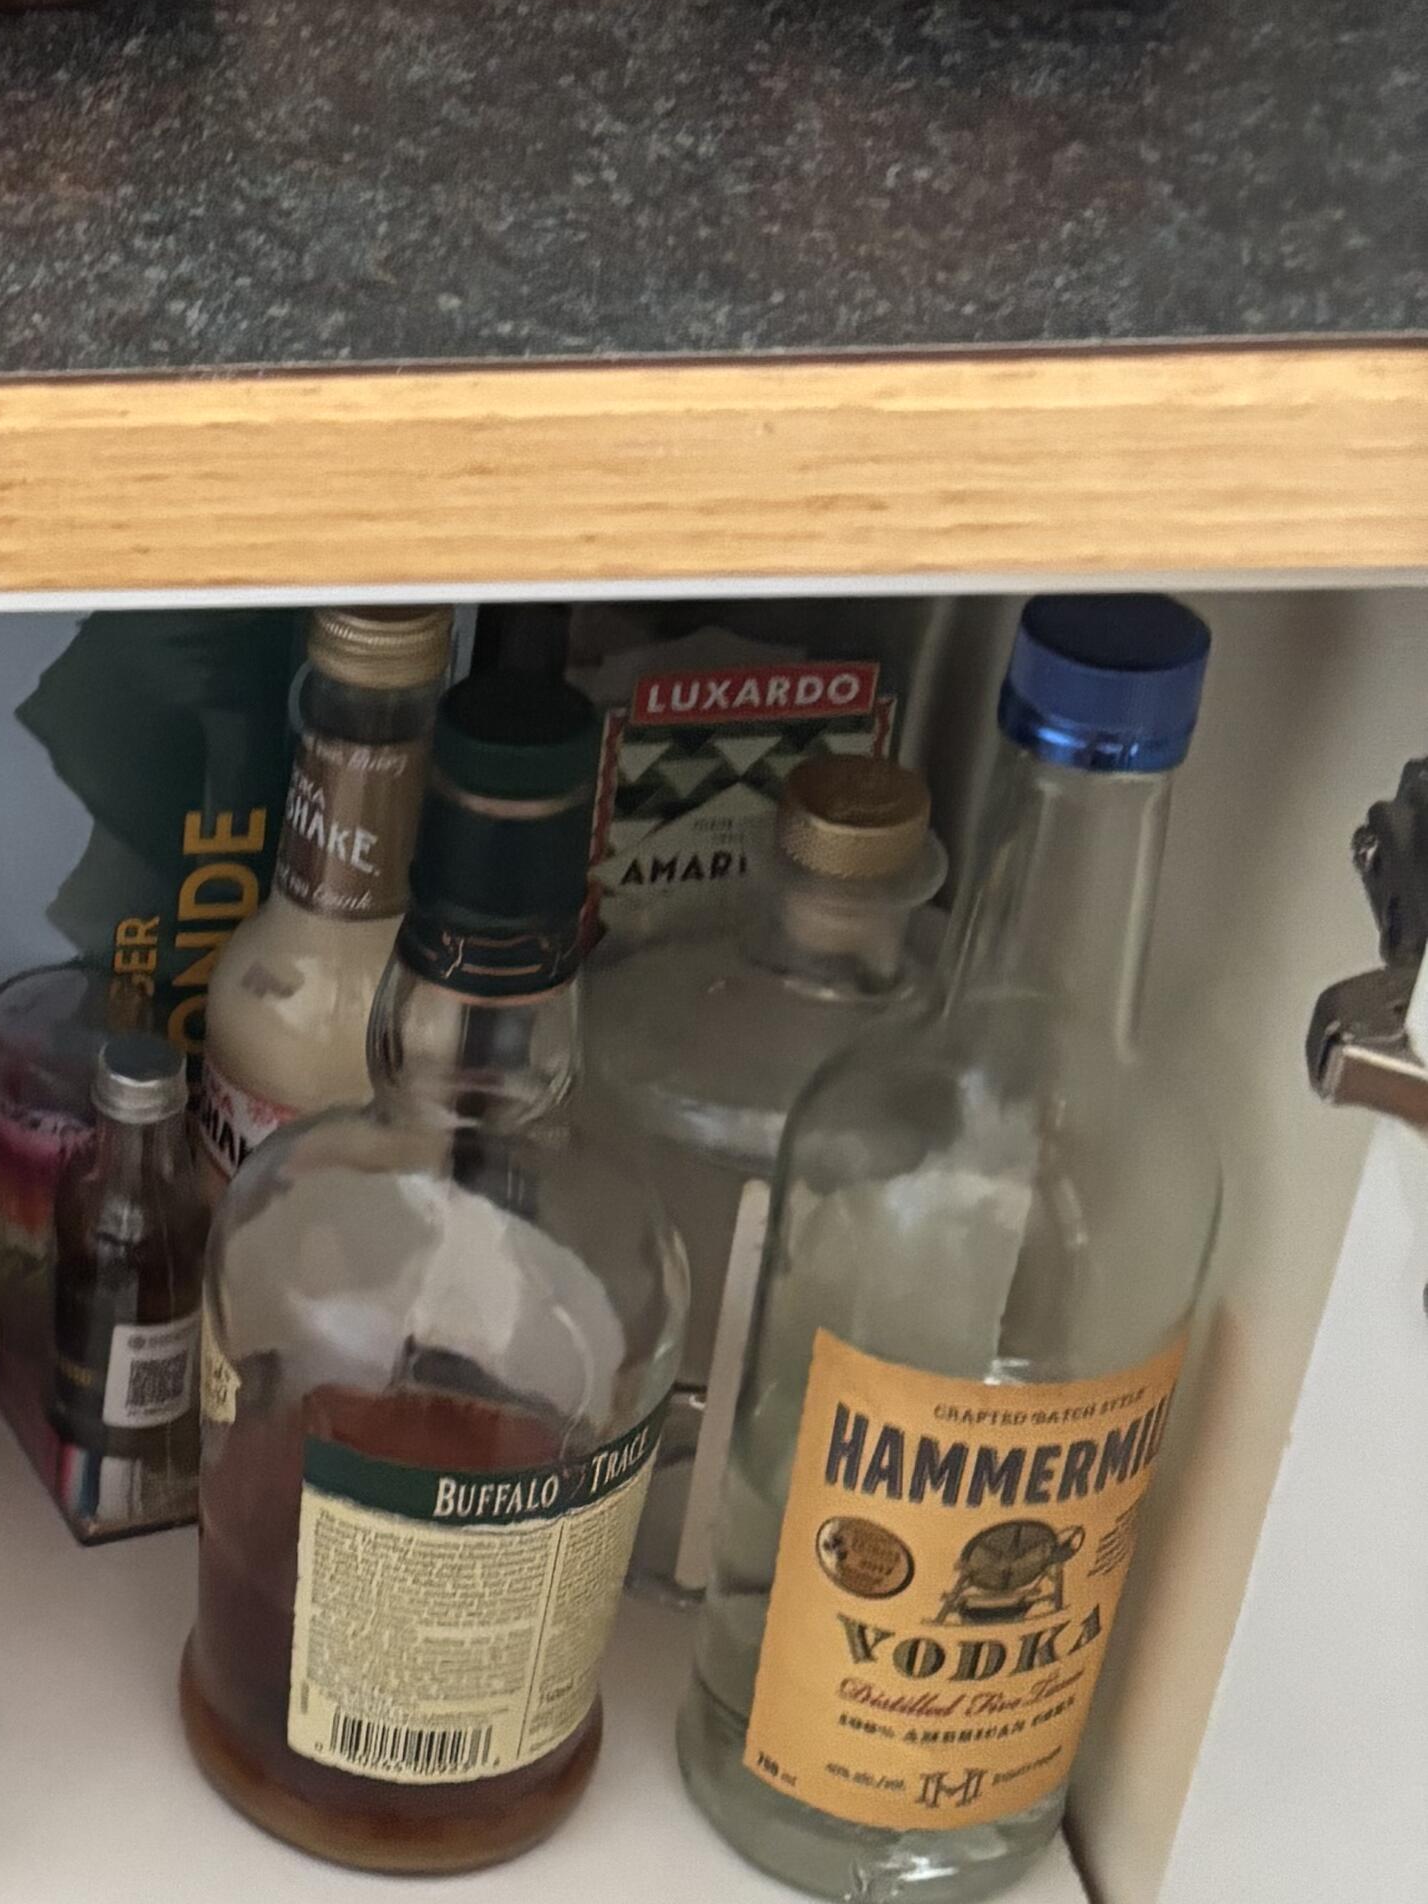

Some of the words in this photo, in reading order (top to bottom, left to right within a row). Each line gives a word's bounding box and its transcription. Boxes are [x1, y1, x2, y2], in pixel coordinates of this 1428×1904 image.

[646, 672, 861, 715] LUXARDO
[433, 1474, 560, 1520] BUFFALO
[589, 1426, 651, 1495] TRACE
[837, 1602, 1102, 1683] VODKA
[839, 1675, 961, 1719] Distilled
